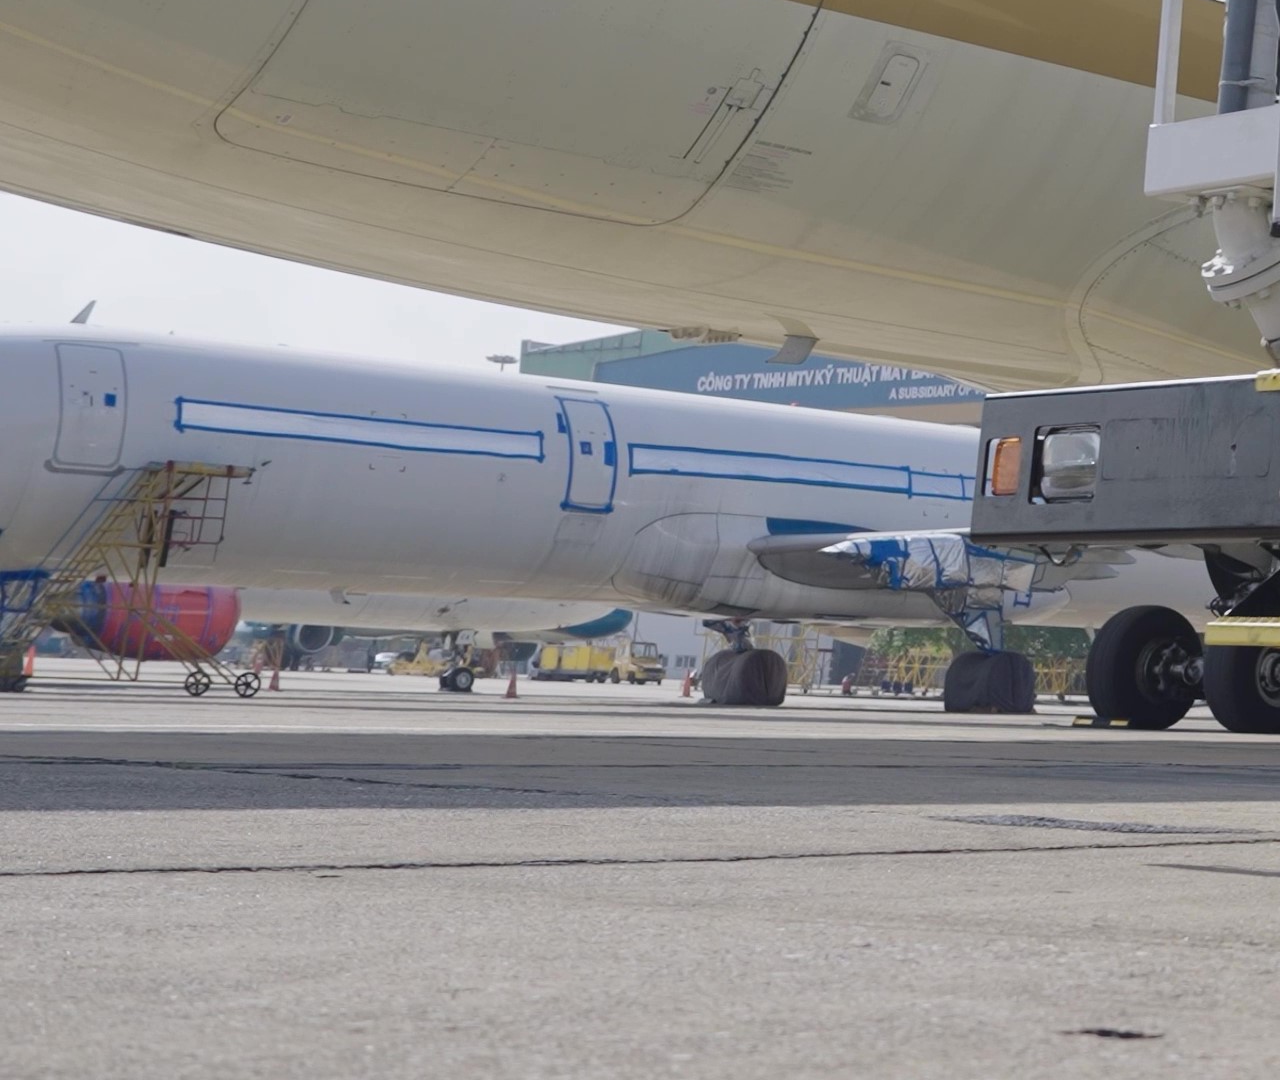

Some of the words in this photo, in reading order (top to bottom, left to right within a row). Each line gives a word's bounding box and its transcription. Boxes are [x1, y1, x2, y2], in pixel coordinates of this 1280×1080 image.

[697, 371, 733, 391] CÔNG
[734, 373, 752, 390] TY
[753, 371, 786, 389] TNHH
[786, 369, 815, 387] MTV
[889, 387, 897, 400] A
[898, 383, 957, 400] SUBSIDIARY
